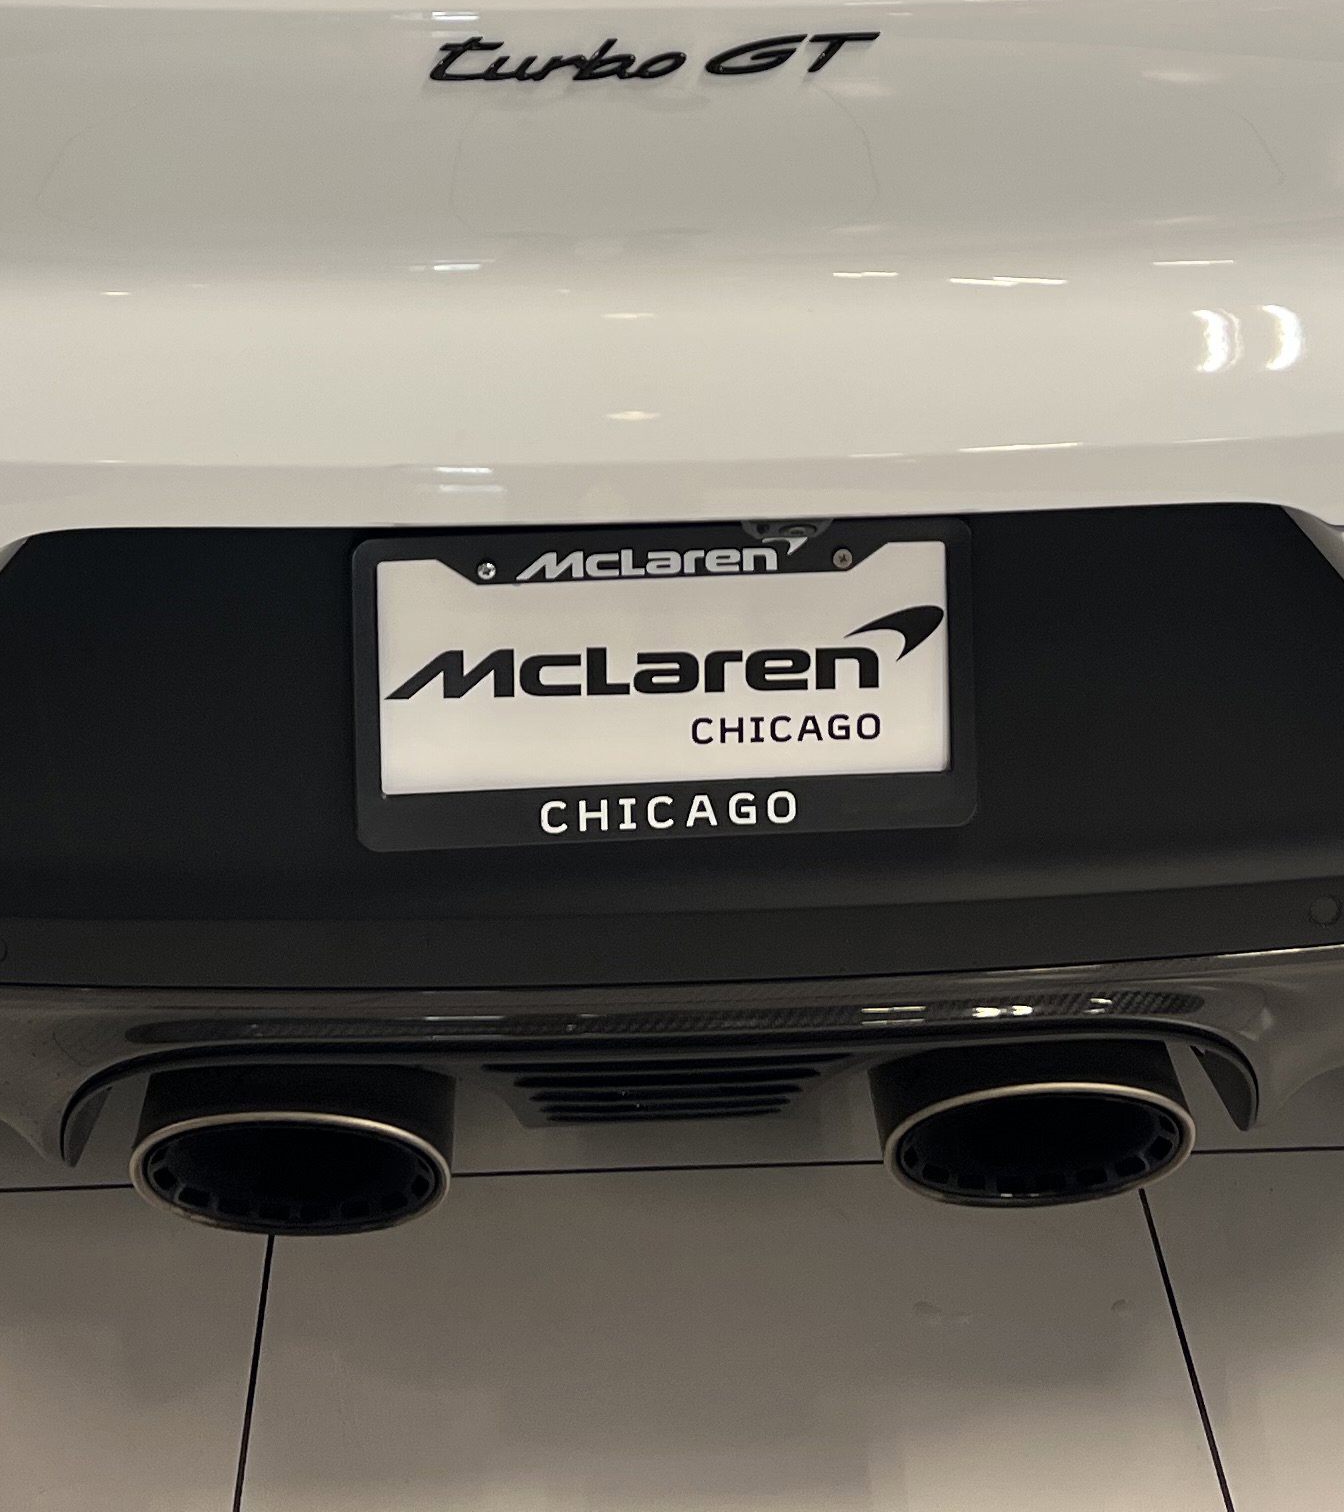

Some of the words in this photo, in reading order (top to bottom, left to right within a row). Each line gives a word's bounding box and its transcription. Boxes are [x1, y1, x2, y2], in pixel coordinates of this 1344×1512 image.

[429, 36, 687, 81] turbo
[705, 31, 881, 74] GT
[516, 547, 778, 580] McLaren
[384, 646, 880, 700] McLaren
[691, 713, 881, 745] CHICAGO
[540, 790, 798, 834] CHICAGO
